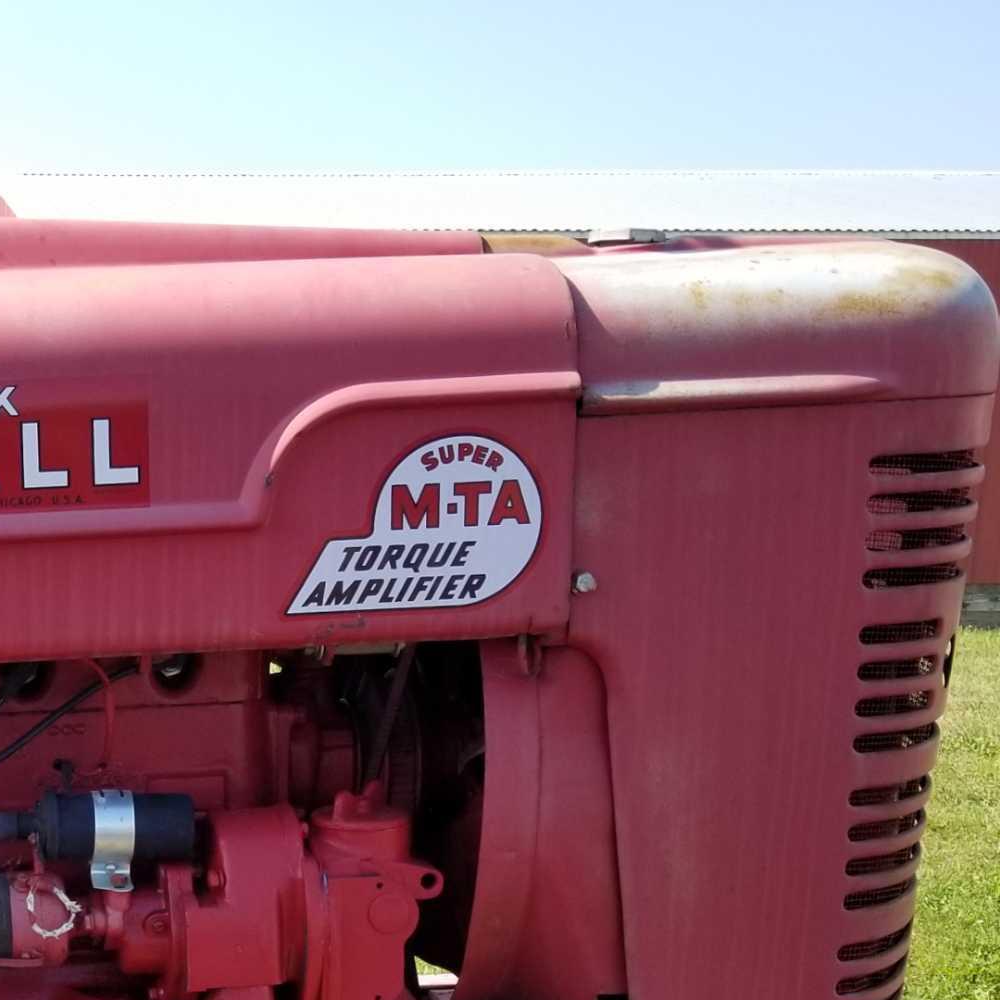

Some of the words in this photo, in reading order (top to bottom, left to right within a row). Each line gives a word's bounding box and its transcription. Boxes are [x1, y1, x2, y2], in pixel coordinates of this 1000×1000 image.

[420, 442, 505, 472] SUPER
[338, 540, 477, 573] TORQUE
[301, 573, 487, 607] AMPLIFIER
